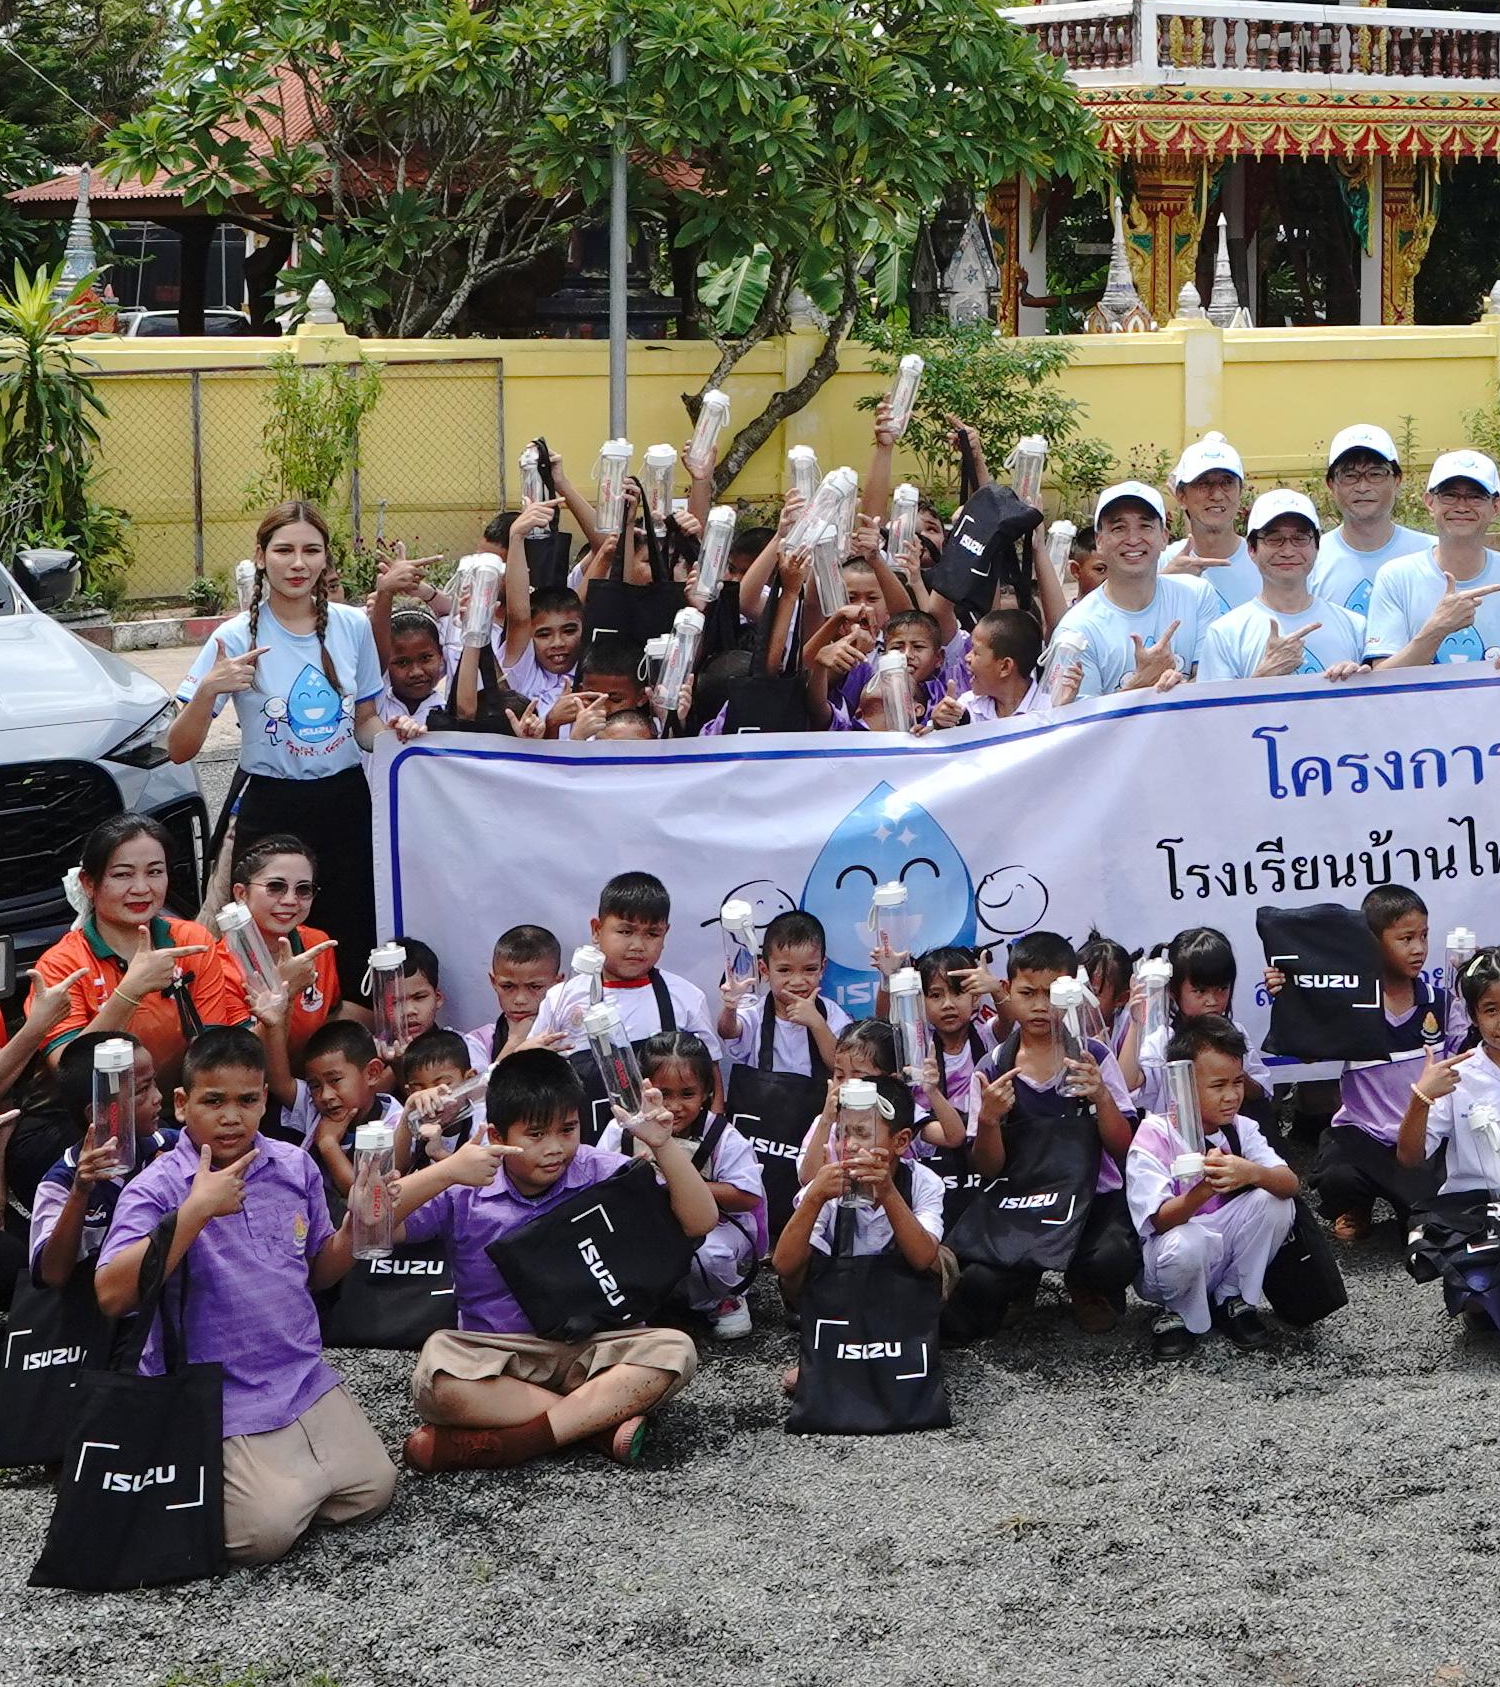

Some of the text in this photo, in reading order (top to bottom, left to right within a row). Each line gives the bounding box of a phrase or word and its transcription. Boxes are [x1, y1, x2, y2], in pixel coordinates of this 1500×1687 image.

[959, 533, 986, 557] ISUZU
[1294, 975, 1360, 990] ISUZU
[998, 1193, 1059, 1210] ISUZU
[369, 1259, 444, 1276] ISUZU
[578, 1237, 627, 1308] ISUZU
[23, 1346, 82, 1371] ISUZU
[102, 1465, 176, 1493] ISUZU
